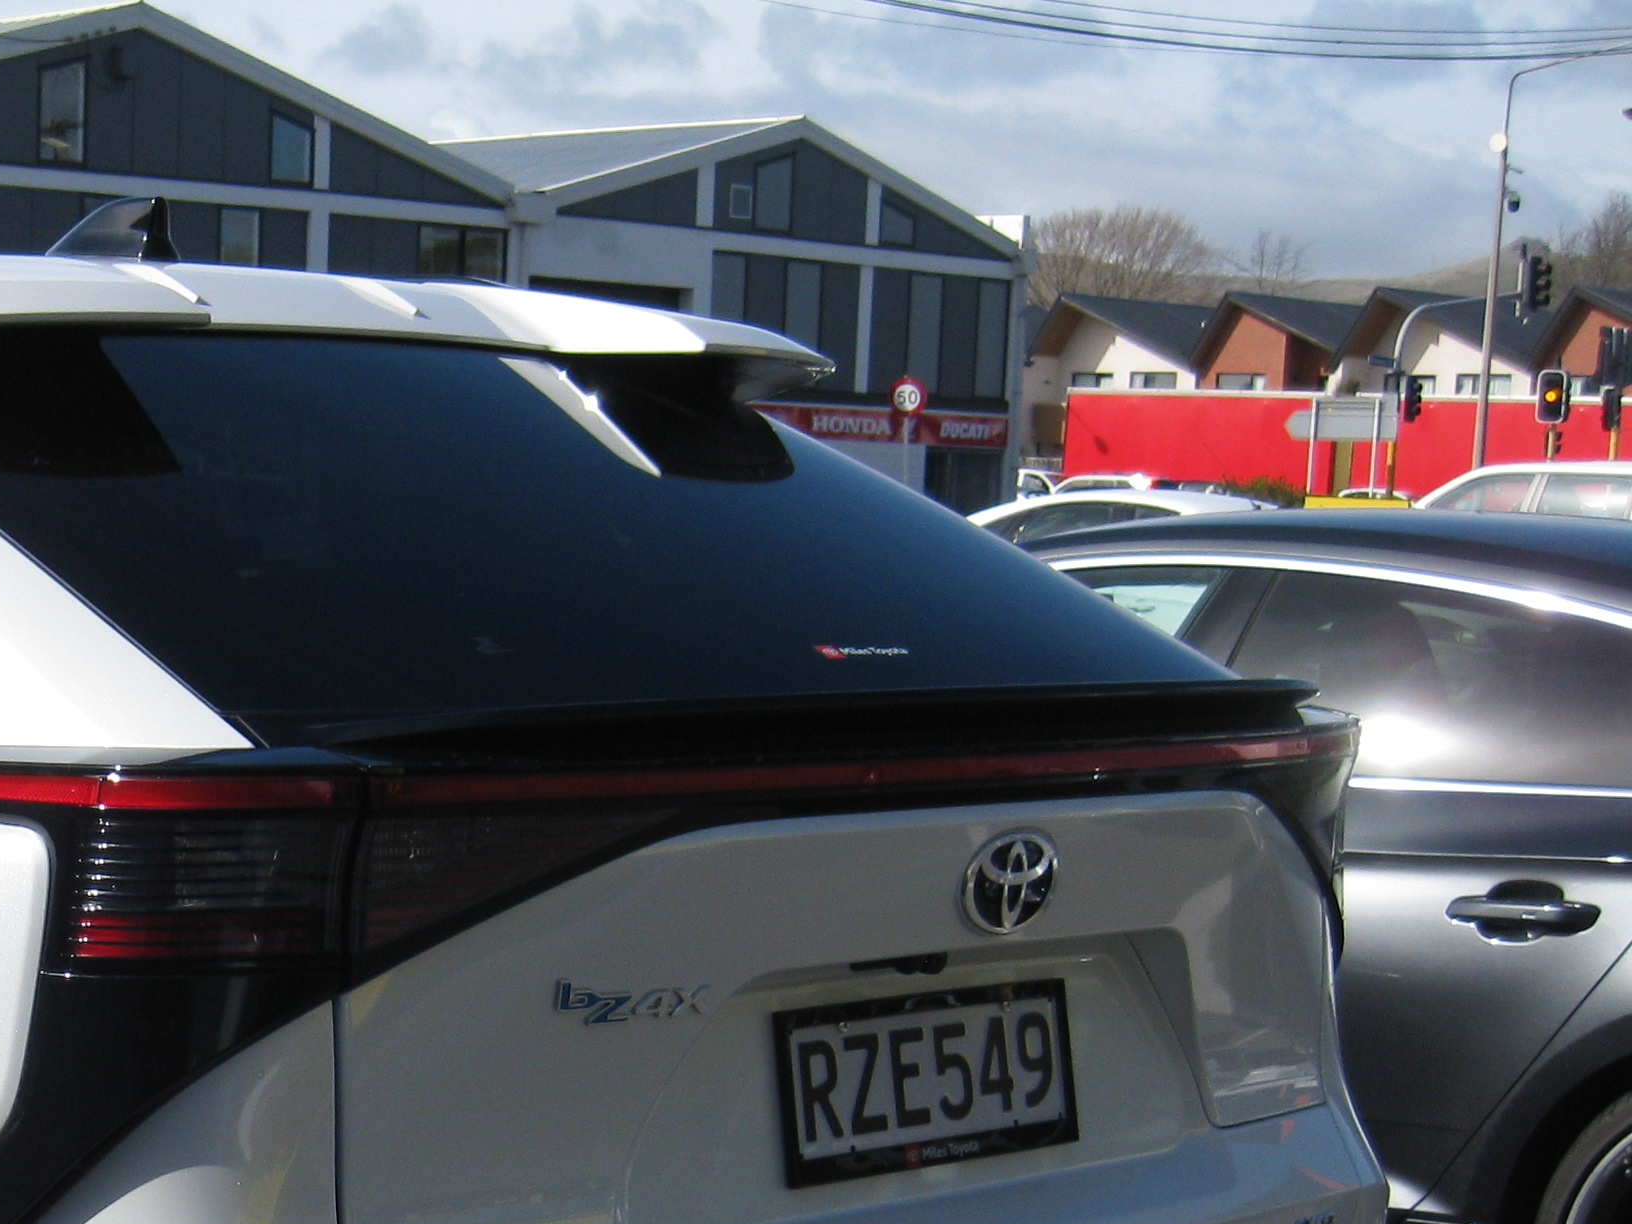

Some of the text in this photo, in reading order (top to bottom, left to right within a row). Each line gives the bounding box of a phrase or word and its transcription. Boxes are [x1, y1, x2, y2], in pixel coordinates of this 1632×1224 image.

[896, 390, 919, 406] 50
[811, 414, 892, 437] HONDA
[939, 421, 991, 441] DUCATI
[796, 1011, 1054, 1143] RZE549
[921, 1140, 980, 1160] Miles Toyota
